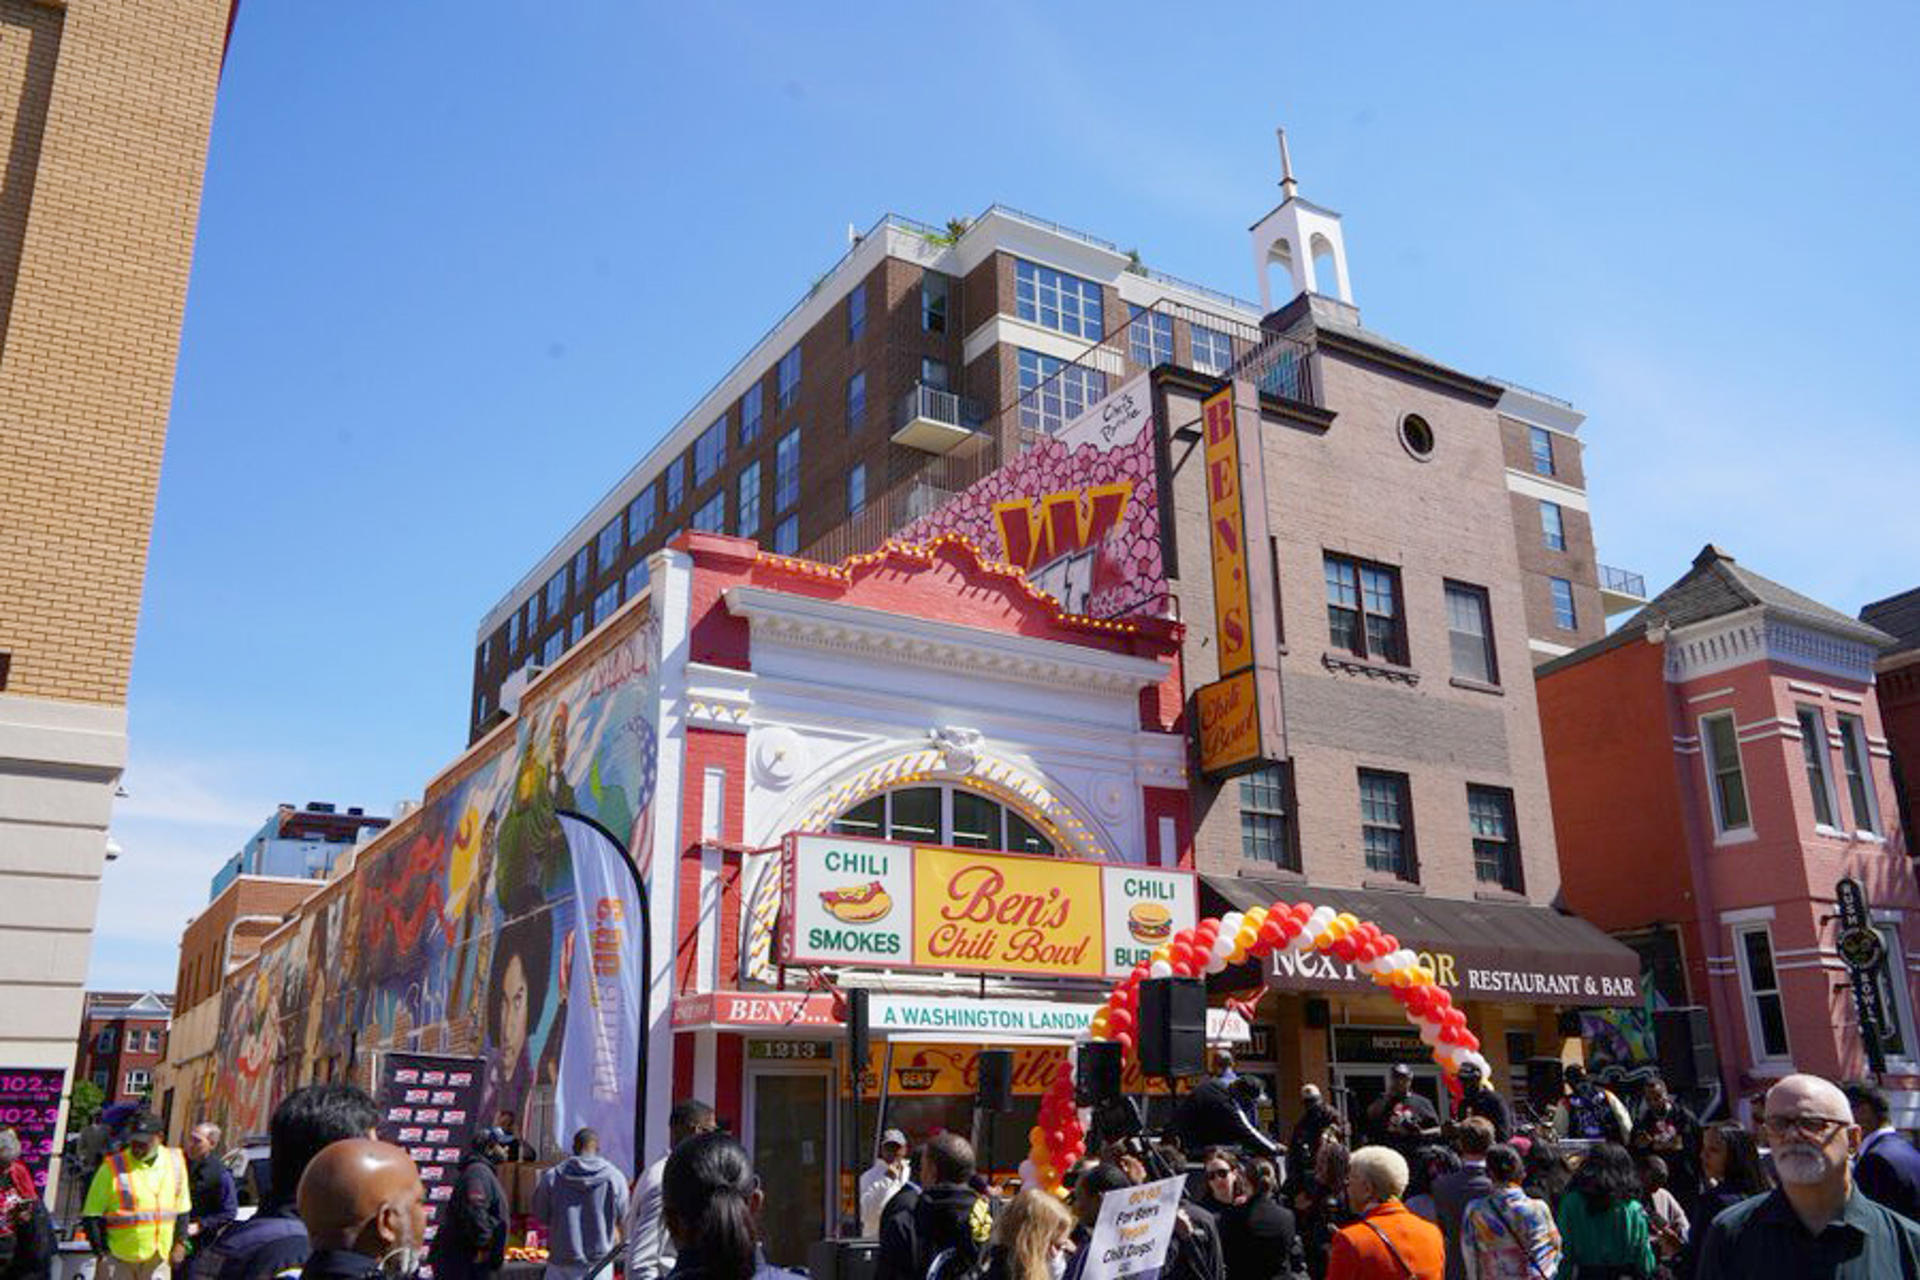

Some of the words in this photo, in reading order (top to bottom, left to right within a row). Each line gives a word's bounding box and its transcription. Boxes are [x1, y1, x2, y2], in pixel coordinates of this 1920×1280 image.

[825, 851, 888, 875] CHILI
[941, 865, 1071, 929] Ben's
[1124, 878, 1175, 899] CHILI
[808, 928, 901, 954] SMOKES
[928, 922, 998, 961] Chili
[1002, 929, 1091, 965] Bowl
[1468, 970, 1580, 994] RESTAURANT
[1584, 975, 1598, 995] &
[1602, 976, 1636, 996] BAR
[884, 1006, 897, 1025] A
[902, 1007, 1024, 1028] WASHINGTON
[1029, 1010, 1089, 1030] LANDM
[763, 1042, 816, 1059] 1213
[2, 1077, 62, 1092] 102.3
[20, 1138, 53, 1154] 2.3
